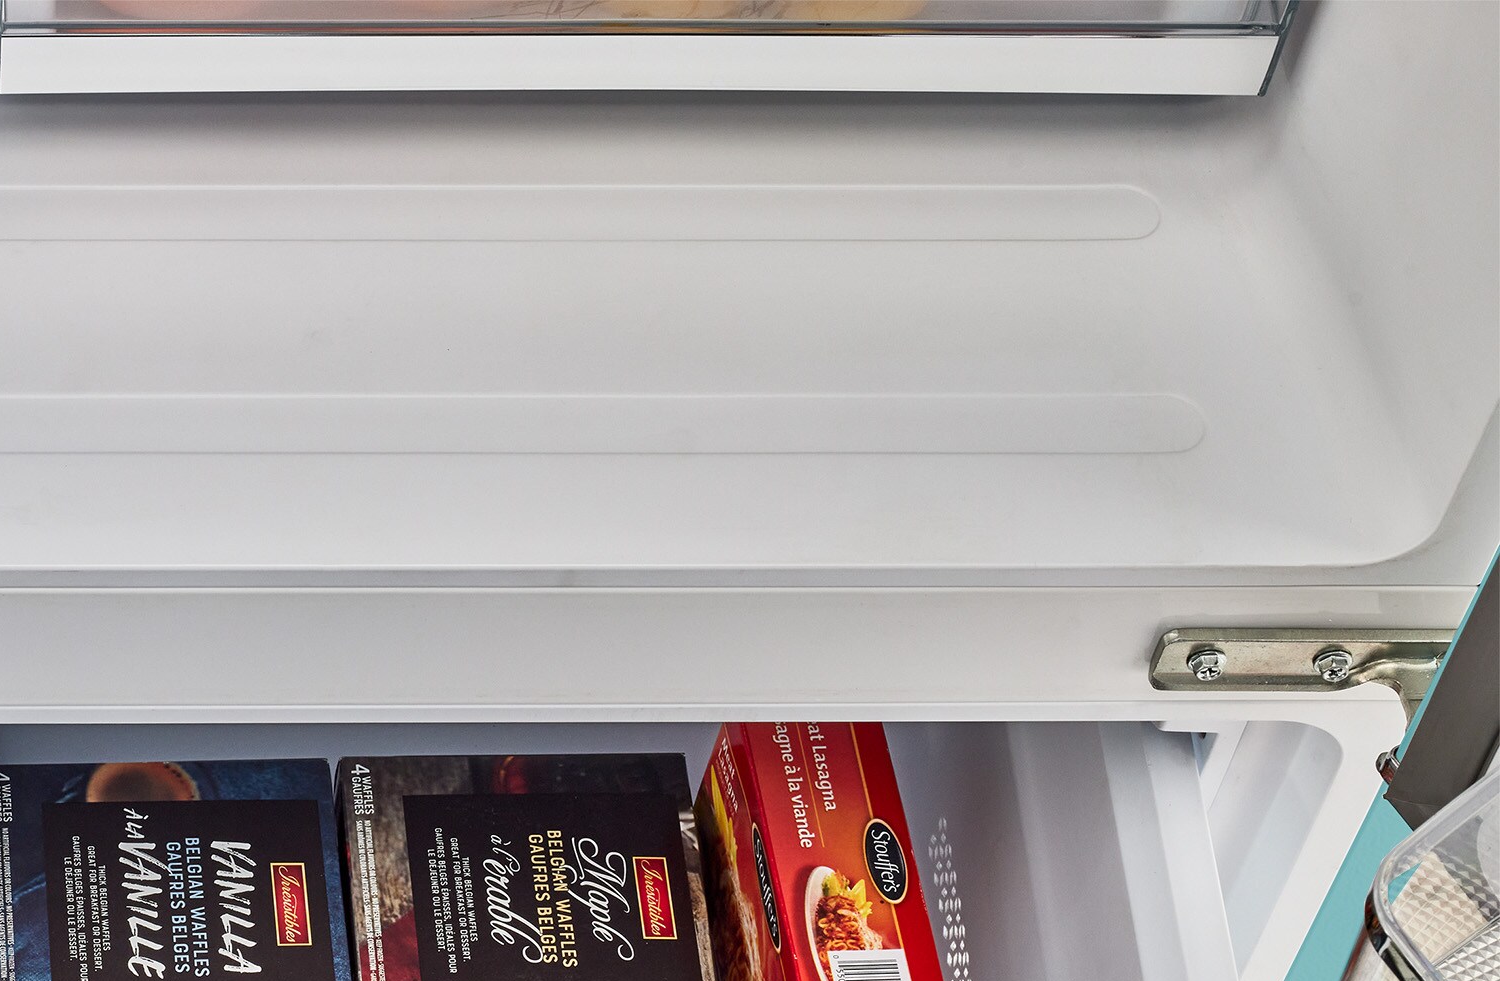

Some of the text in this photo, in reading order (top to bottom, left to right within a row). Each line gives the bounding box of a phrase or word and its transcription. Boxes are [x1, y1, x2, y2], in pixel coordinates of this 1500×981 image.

[720, 737, 736, 780] Meat
[784, 766, 801, 775] à
[806, 721, 837, 812] at Lasagna
[351, 764, 375, 815] 4 WAFFLES
[351, 776, 364, 815] GAUFRES
[717, 749, 739, 812] Lasagna
[787, 777, 803, 793] la
[1, 783, 13, 822] WAFFLES
[791, 795, 816, 849] viande
[63, 856, 72, 864] LE
[71, 835, 81, 866] GAUFRES
[426, 848, 436, 856] LE
[434, 827, 445, 858] GAUFRES
[871, 829, 900, 893] Stouffer's
[73, 868, 83, 894] BELGES
[437, 860, 448, 886] BELGES
[754, 838, 778, 937] Stouffer's
[66, 904, 75, 915] OU
[86, 845, 102, 971] GREAT FOR BREAKFAST OR DESSERT.
[97, 864, 111, 951] THICK BELGIAN WAFFLES
[118, 842, 172, 980] VANILLE
[165, 841, 190, 972] GAUFRES BELGES
[185, 837, 209, 976] BELGIAN WAFFLES
[210, 840, 262, 974] VANILLA
[278, 866, 301, 943] Irresistibles
[431, 895, 440, 906] OU
[433, 908, 442, 916] LE
[449, 837, 471, 962] GREAT FOR BREAKFAST OR DESSERT.
[461, 856, 478, 941] THICK BELGIAN WAFFLES
[528, 834, 558, 963] GAUFRES BELGES
[546, 830, 577, 967] BELGIAN WAFFLES
[562, 837, 634, 961] Maple
[641, 860, 666, 936] Irresistibles
[67, 916, 76, 925] LE
[434, 919, 445, 952] DESSERT.
[444, 923, 455, 952] IDÉALES
[67, 927, 77, 960] DESSERT.
[77, 932, 87, 961] IDÉALES
[447, 953, 457, 973] POUR
[79, 963, 88, 981] POUR
